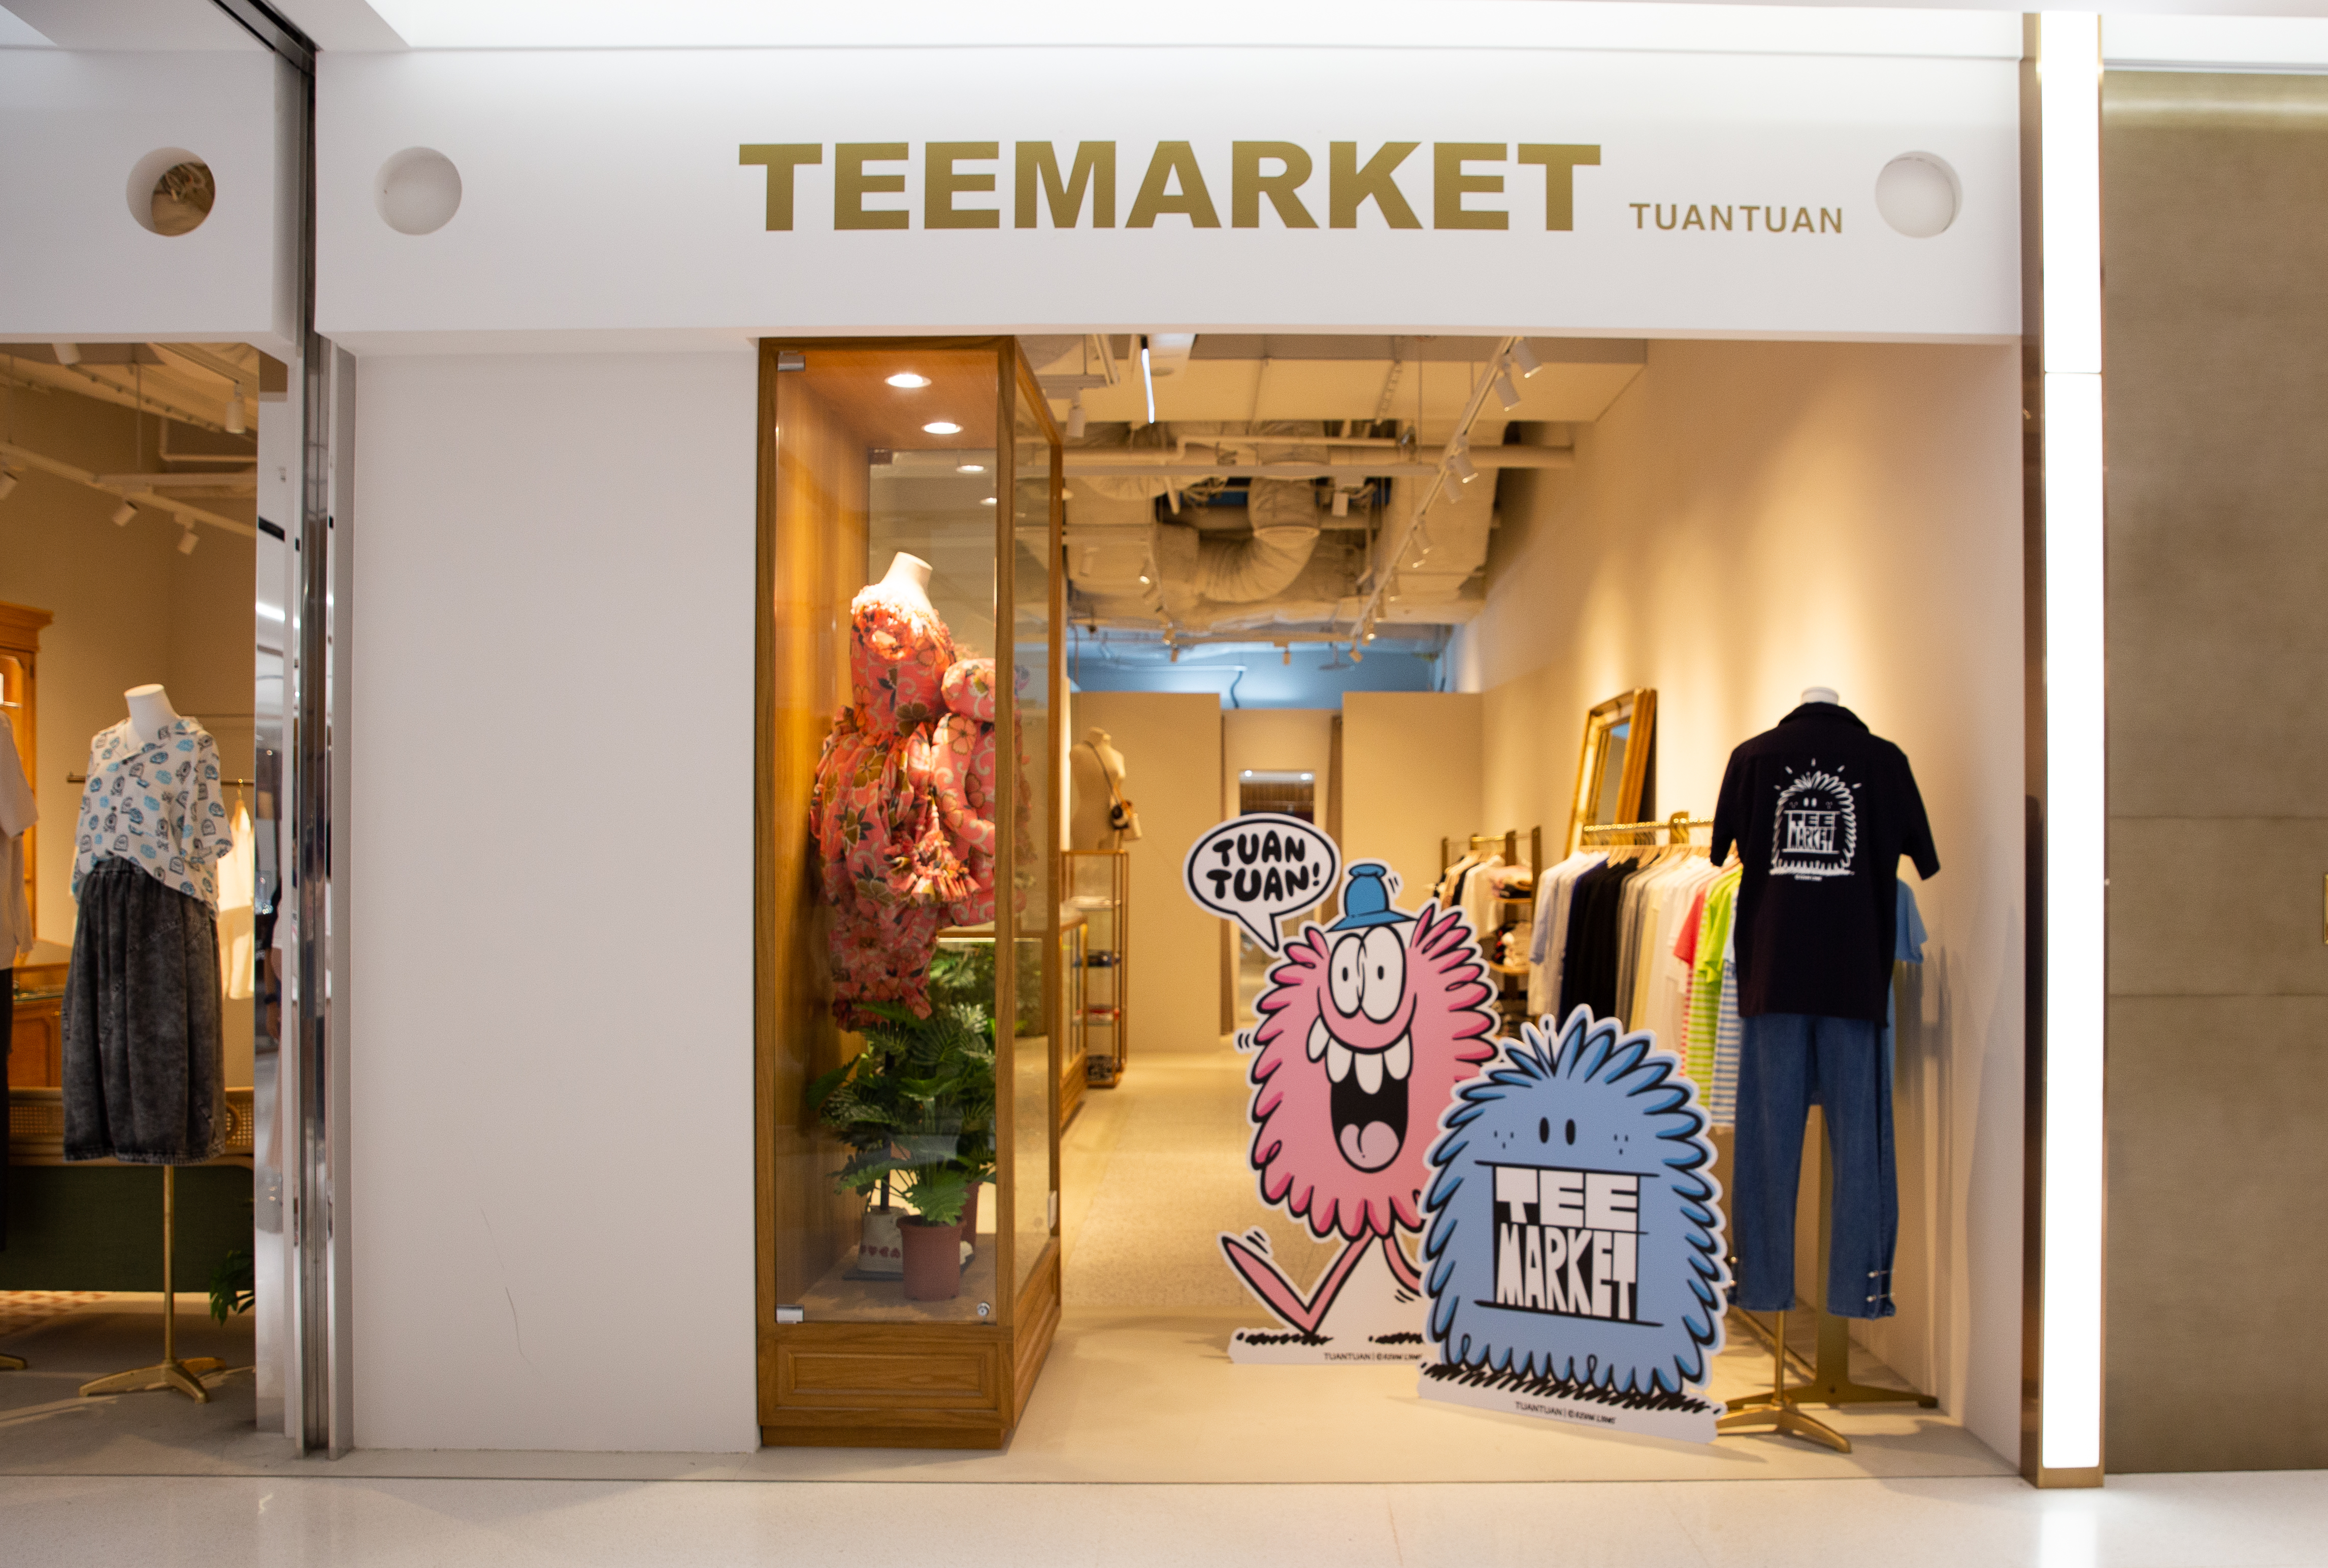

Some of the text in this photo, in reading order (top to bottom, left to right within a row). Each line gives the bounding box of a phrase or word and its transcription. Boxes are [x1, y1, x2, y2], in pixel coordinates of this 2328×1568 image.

[739, 141, 1842, 234] TEEMARKET TUANTUAN
[1791, 813, 1833, 827] TEE
[1212, 830, 1305, 867] TUAN
[1206, 862, 1320, 902] TUAN!
[1496, 1166, 1638, 1232] TEE
[1496, 1222, 1637, 1320] MARKET
[1324, 1352, 1370, 1361] TUANTUAN
[1515, 1401, 1562, 1416] TUANTUAN
